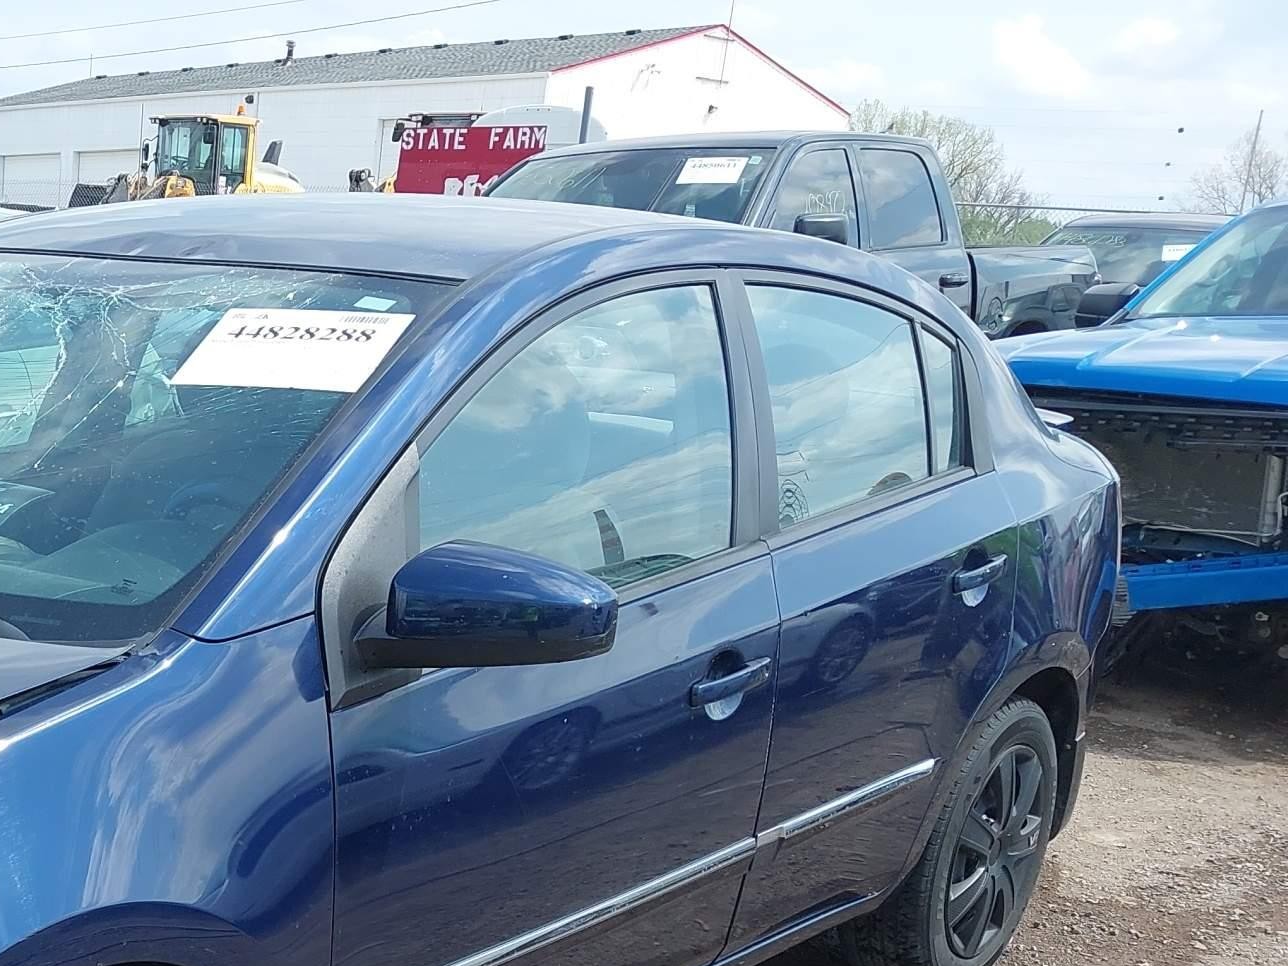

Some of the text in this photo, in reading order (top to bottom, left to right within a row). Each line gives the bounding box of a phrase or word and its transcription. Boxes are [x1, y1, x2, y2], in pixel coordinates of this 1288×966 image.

[401, 127, 547, 150] STATE FARM
[228, 325, 377, 342] 44828288
